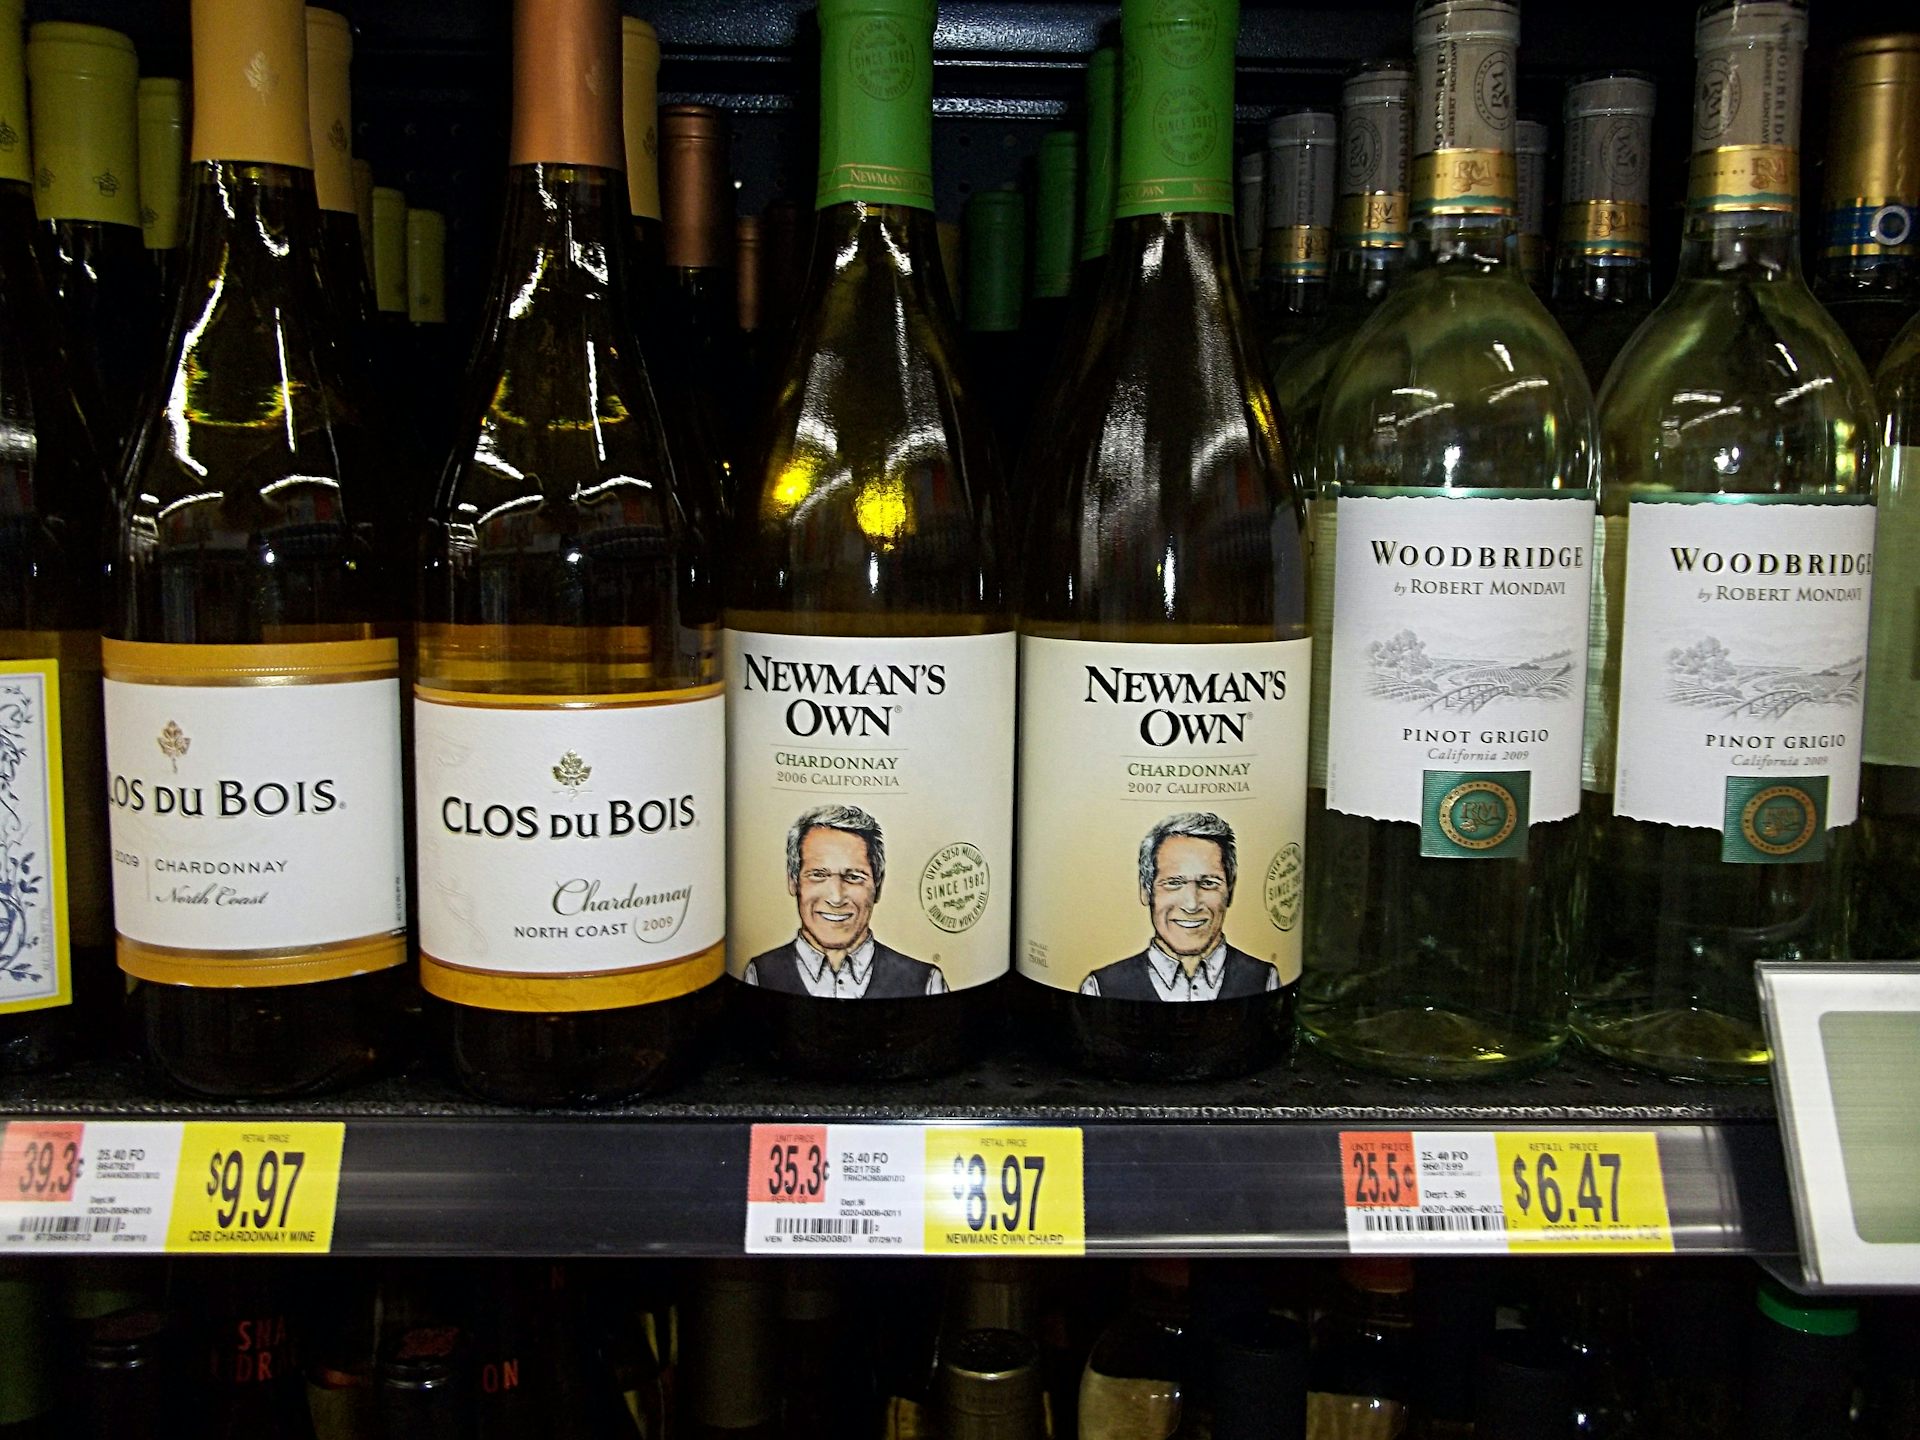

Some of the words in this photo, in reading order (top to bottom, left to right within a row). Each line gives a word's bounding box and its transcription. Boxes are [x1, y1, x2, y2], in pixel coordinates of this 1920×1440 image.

[1370, 540, 1584, 569] WOODBRIDGE
[1394, 581, 1407, 597] by
[1410, 578, 1484, 596] ROBERT
[1489, 580, 1566, 596] MONDAVI
[1698, 587, 1712, 603] by
[1715, 585, 1791, 602] ROBERT
[1795, 587, 1862, 602] MONDAVI
[743, 652, 947, 696] NEWMAN'S
[1083, 665, 1288, 704] NEWMAN'S
[785, 698, 892, 737] OWN
[1139, 708, 1246, 747] OWN
[1402, 727, 1472, 743] PINOT
[1479, 728, 1550, 743] GRIGIO
[1705, 733, 1775, 749] PINOT
[1783, 734, 1846, 749] GRIGIO
[775, 751, 899, 771] CHARDONNAY
[1427, 748, 1498, 764] California
[1501, 750, 1530, 761] 2009
[1731, 754, 1800, 770] California
[1127, 762, 1251, 778] CHARDONNAY
[776, 771, 807, 785] 2006
[811, 772, 900, 788] CALIFORNIA
[1127, 782, 1162, 795] 2007
[1166, 781, 1251, 795] CALIFORNIA
[154, 785, 205, 817] DU
[218, 779, 338, 817] BOIS
[442, 796, 540, 840] CLOS
[550, 812, 600, 840] DU
[608, 794, 697, 834] BOIS
[155, 858, 289, 875] CHARDONNAY
[155, 882, 212, 906] North
[214, 885, 269, 907] Coast
[926, 880, 959, 901] SINCE
[963, 871, 985, 891] 1982
[551, 878, 693, 925] Chardonnay
[513, 925, 569, 939] NORTH
[575, 922, 629, 939] COAST
[642, 915, 674, 932] 2009
[268, 1133, 292, 1143] PRICE
[794, 1134, 815, 1143] PRICE
[980, 1138, 1005, 1147] RETAIL
[1006, 1138, 1028, 1148] PRICE
[1351, 1142, 1376, 1151] UNIT
[1381, 1142, 1411, 1151] PRICE
[1529, 1142, 1564, 1151] RETAIL
[1569, 1142, 1599, 1151] PRICE
[842, 1152, 871, 1164] 25.40
[873, 1152, 889, 1164] FO
[1452, 1151, 1469, 1161] FO
[206, 1148, 305, 1229] $9.97
[952, 1153, 1046, 1232] $8.97
[1513, 1152, 1622, 1224] $6.47
[189, 1230, 211, 1243] CDB
[213, 1230, 288, 1243] CHARDONNAY
[289, 1230, 317, 1243] WINE
[945, 1233, 999, 1245] NEWMANS
[1001, 1233, 1025, 1245] OWN
[1028, 1234, 1065, 1246] CHARD
